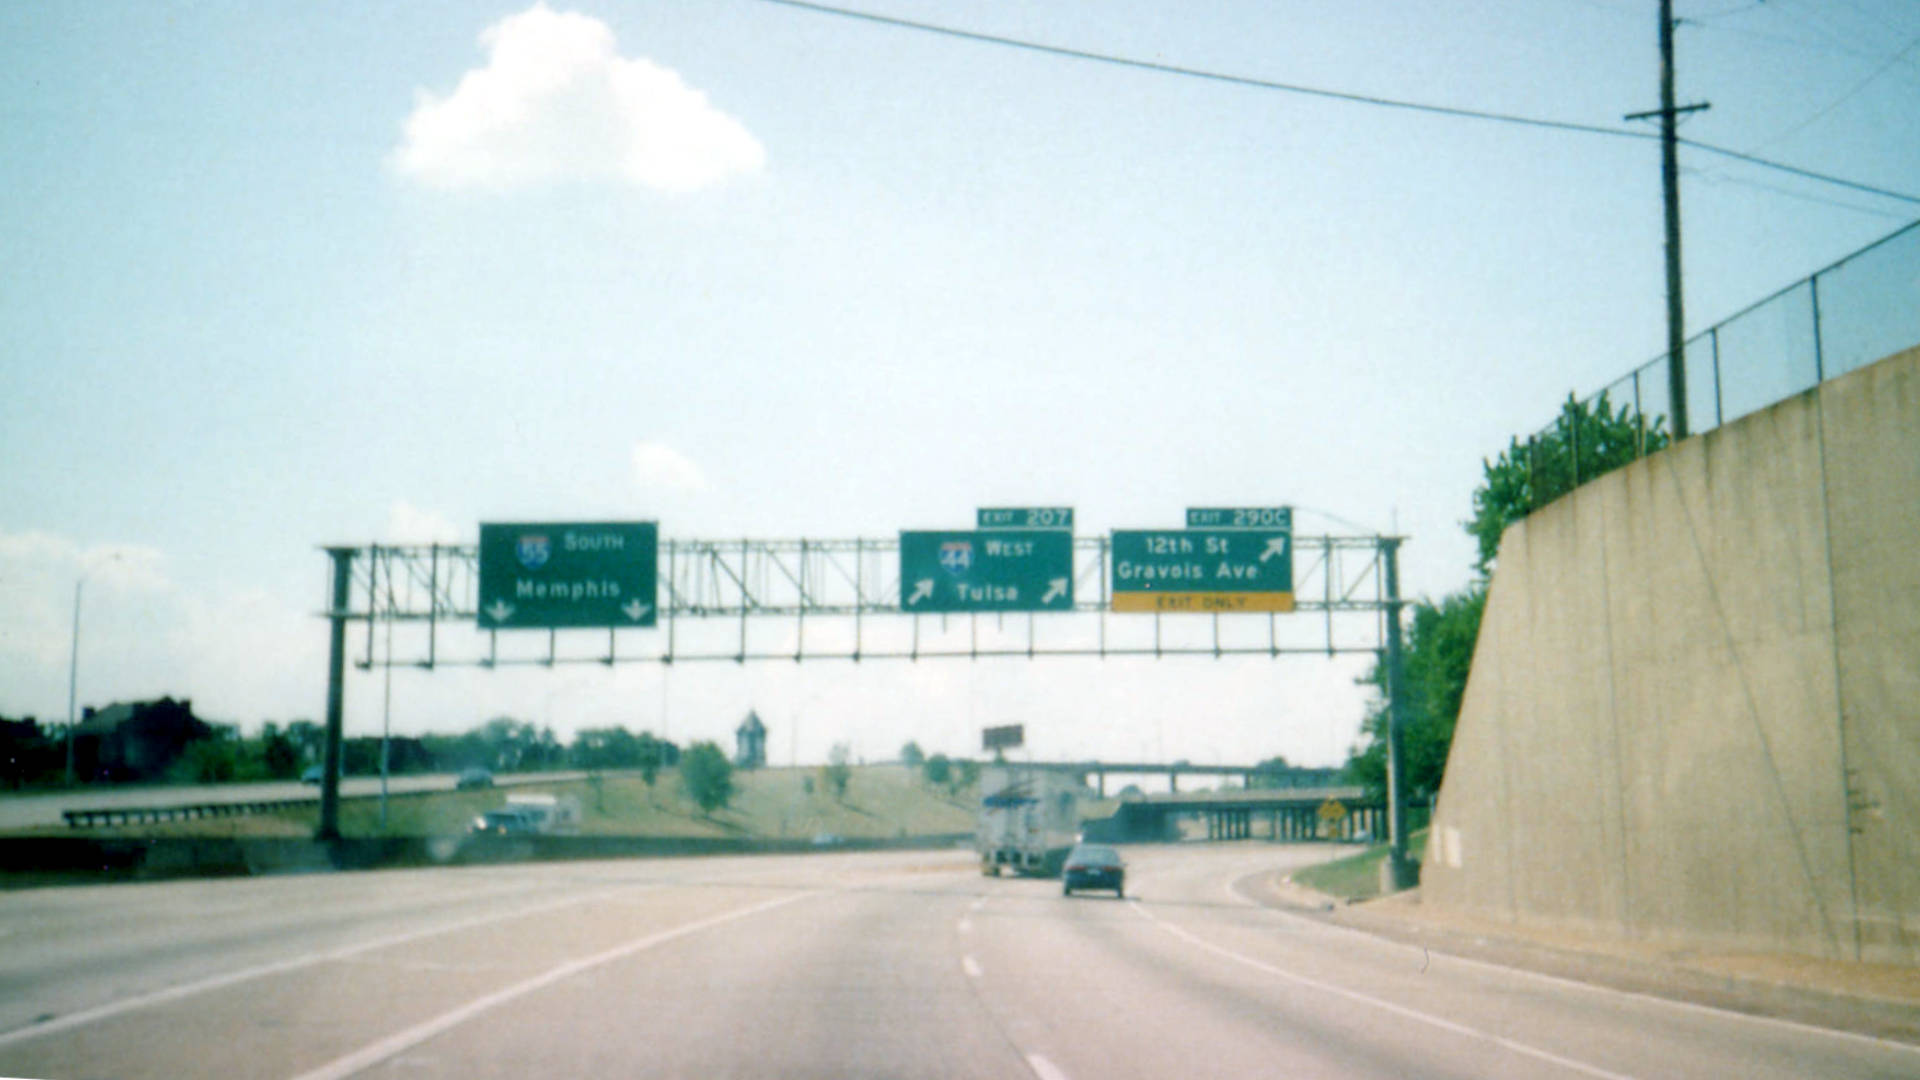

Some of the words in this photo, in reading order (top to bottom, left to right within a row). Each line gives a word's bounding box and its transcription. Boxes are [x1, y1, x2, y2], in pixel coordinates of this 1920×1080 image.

[1027, 510, 1068, 526] 207
[1190, 511, 1221, 523] EXIT
[1233, 509, 1287, 525] 290C
[1146, 537, 1193, 553] 12th
[1205, 537, 1229, 553] St
[941, 550, 971, 567] 44
[1117, 561, 1203, 579] Gravois
[1216, 562, 1258, 578] Ave
[516, 579, 621, 600] Memphis
[957, 584, 1018, 601] Tulsa
[1157, 597, 1192, 608] EXIT
[1203, 597, 1247, 608] ONLY
